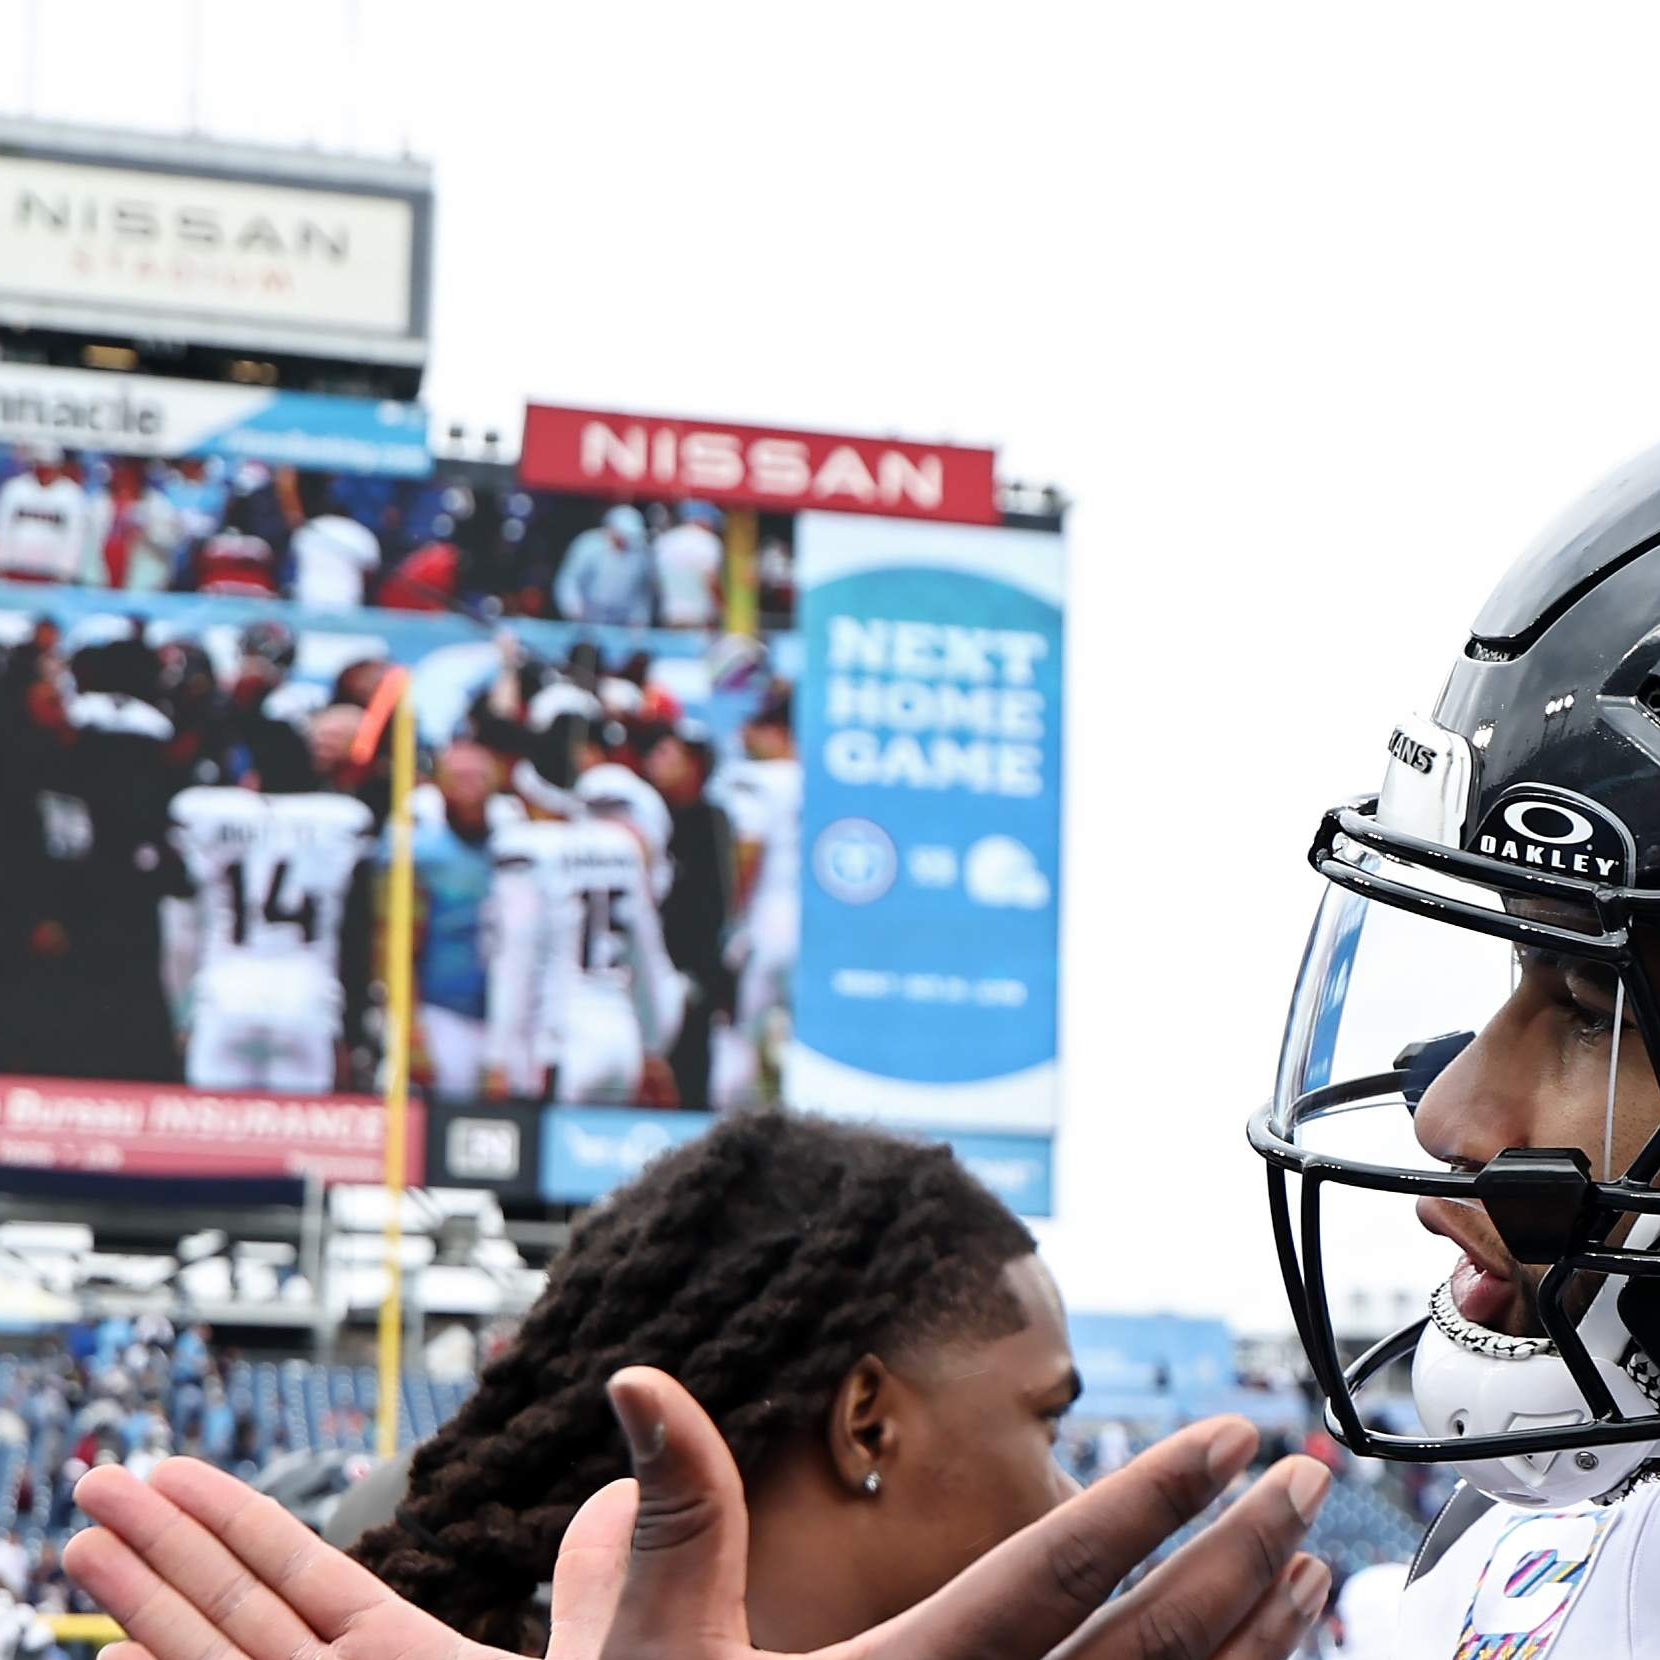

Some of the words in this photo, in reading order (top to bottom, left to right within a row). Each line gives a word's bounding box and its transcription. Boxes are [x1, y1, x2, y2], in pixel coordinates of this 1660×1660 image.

[15, 186, 353, 264] NISSAN
[580, 420, 945, 510] NISSAN
[826, 614, 1048, 685] NEXT
[825, 672, 1045, 738] HOME
[823, 729, 1043, 796] GAME
[1479, 833, 1618, 877] OAKLEY
[224, 861, 317, 946] 14
[575, 887, 632, 972] 15
[149, 1094, 385, 1140] INSURANCE
